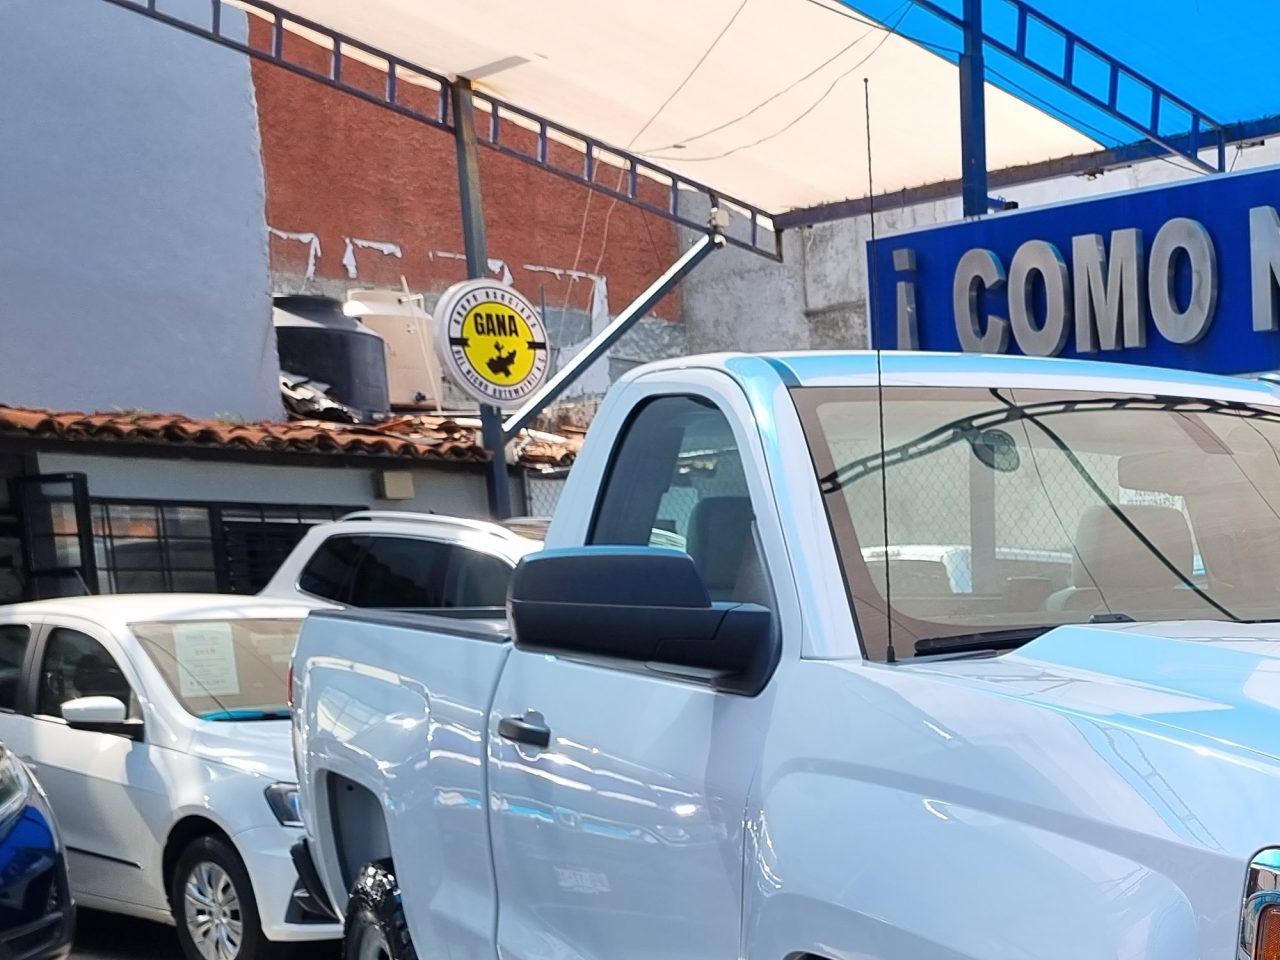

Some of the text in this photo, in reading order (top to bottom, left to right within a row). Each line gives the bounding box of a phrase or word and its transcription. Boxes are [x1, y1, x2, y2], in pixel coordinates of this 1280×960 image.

[952, 216, 1216, 358] COMO
[453, 293, 478, 326] GRUPO
[473, 312, 519, 337] GANA
